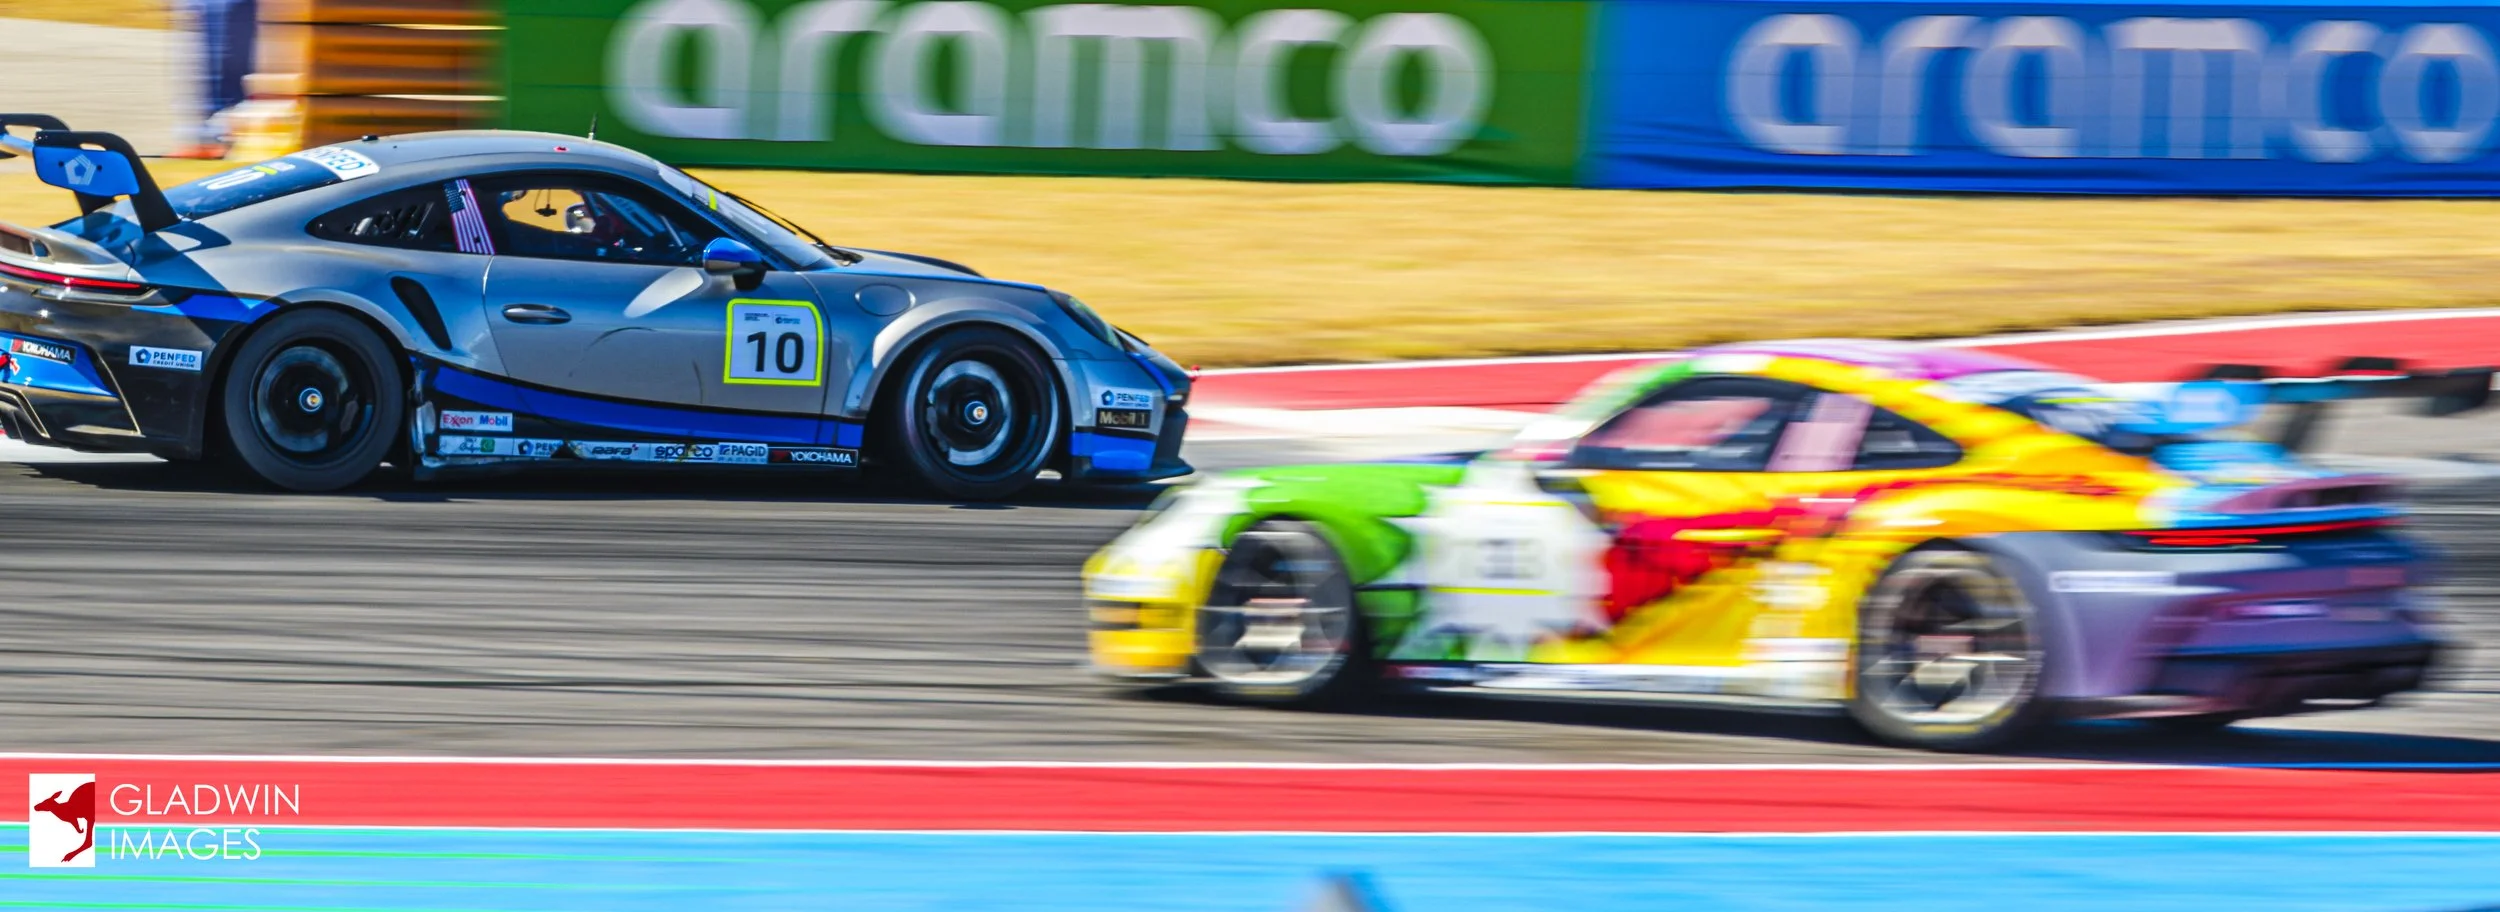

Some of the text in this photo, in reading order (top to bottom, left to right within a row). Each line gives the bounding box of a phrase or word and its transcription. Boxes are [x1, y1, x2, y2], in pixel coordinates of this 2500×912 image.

[608, 0, 1495, 155] aramco
[1720, 13, 2496, 163] aramco
[22, 340, 71, 360] YOKOHAMA
[153, 351, 196, 363] PENFED
[747, 331, 804, 374] 10
[443, 413, 508, 427] Exxon Mobil
[1099, 411, 1137, 425] Mobil
[655, 445, 713, 459] spaco
[732, 445, 766, 457] PAGID
[790, 450, 853, 464] YOKOHAMA
